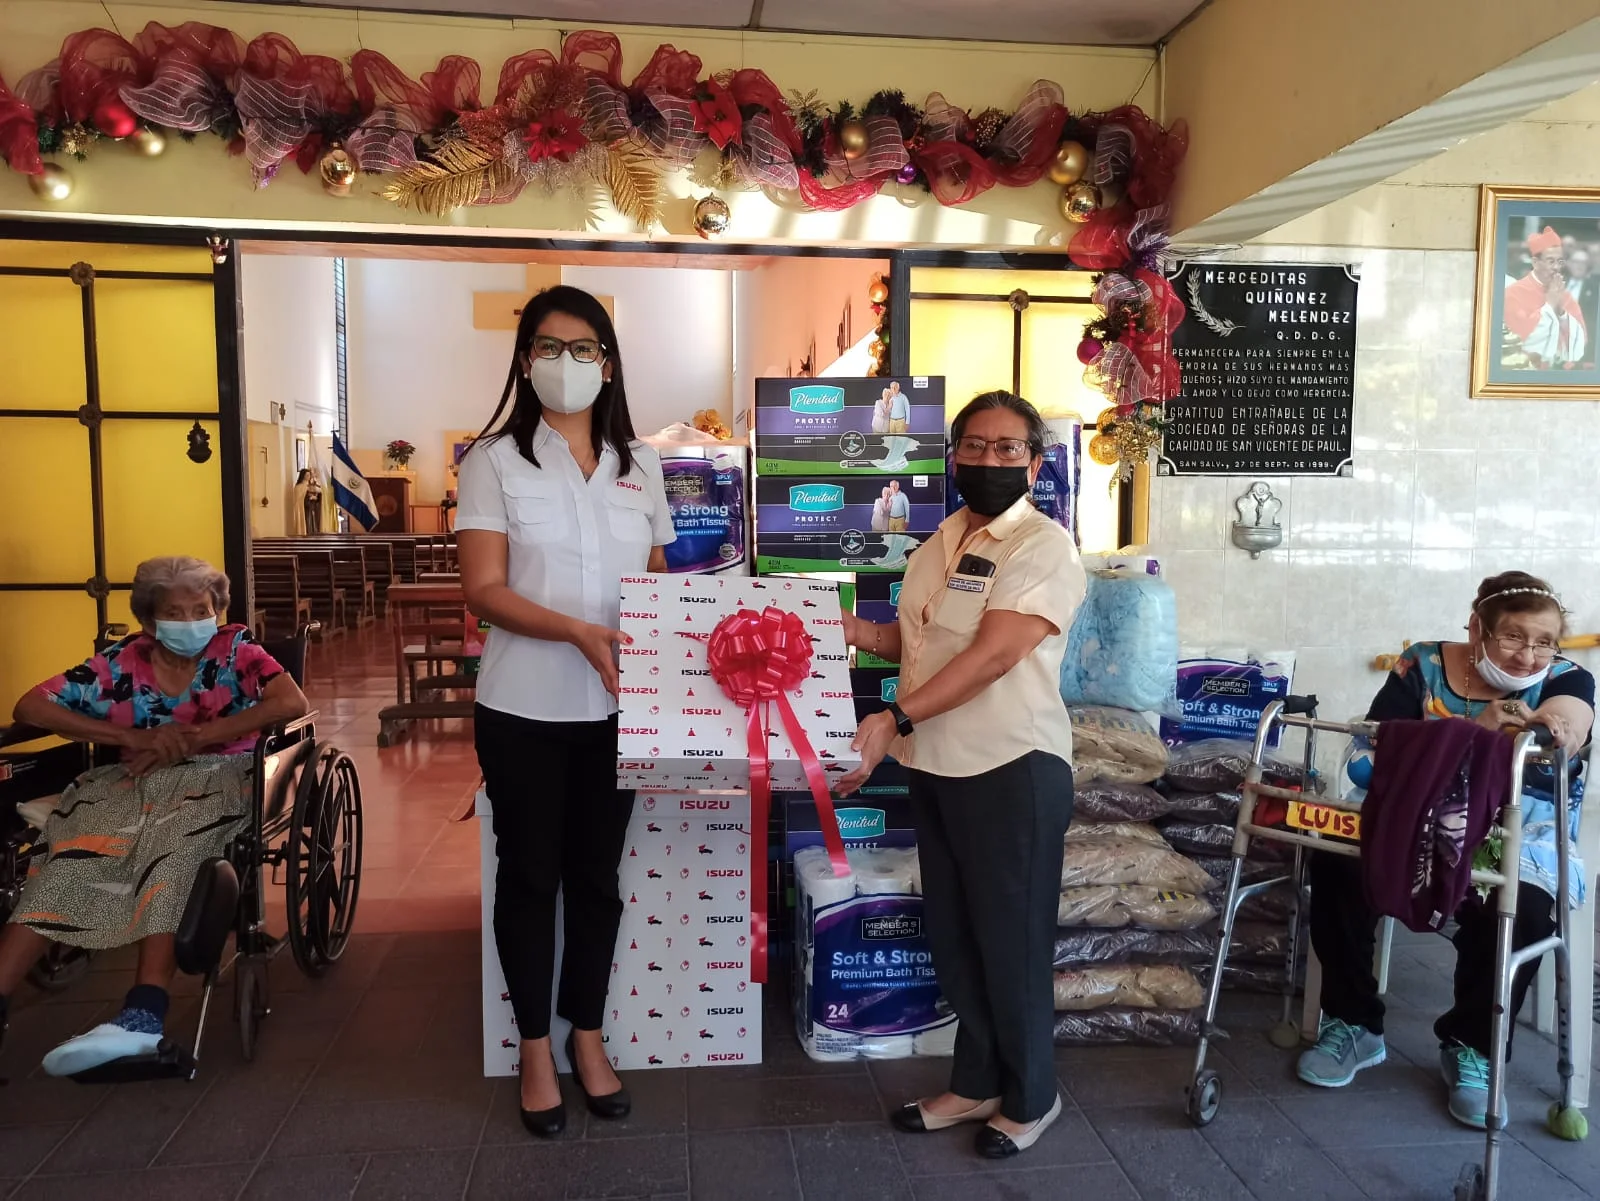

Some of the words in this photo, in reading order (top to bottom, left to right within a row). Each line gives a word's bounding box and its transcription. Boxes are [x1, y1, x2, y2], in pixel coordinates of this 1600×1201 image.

[1205, 271, 1307, 284] MERCEDITAS
[1245, 288, 1327, 304] QUIÑONEZ
[1268, 310, 1350, 323] MELENDEZ
[1172, 348, 1240, 358] PERMANECERA
[1246, 349, 1271, 358] PARA
[1277, 349, 1316, 358] SIEMPRE
[1322, 349, 1333, 358] EN
[1338, 349, 1350, 358] LA
[1180, 362, 1218, 370] EMORIA
[1224, 362, 1236, 371] DE
[1243, 362, 1262, 370] SUS
[1269, 362, 1323, 371] HERMANOS
[1329, 362, 1348, 371] MAS
[1226, 375, 1246, 384] HIZO
[1250, 376, 1273, 384] SUYO
[1276, 376, 1286, 384] EL
[1290, 376, 1349, 384] MANDAMIENTO
[1192, 388, 1217, 398] AMOR
[1222, 388, 1227, 398] Y
[1231, 389, 1242, 398] LO
[1248, 389, 1270, 398] DEJO
[1276, 389, 1299, 398] COMO
[794, 392, 840, 407] Plenitud
[1170, 406, 1224, 418] GRATITUD
[1232, 404, 1304, 418] ENTRAÑABLE
[1312, 407, 1326, 418] DE
[1334, 407, 1346, 418] LA
[1170, 423, 1224, 435] SOCIEDAD
[1232, 424, 1246, 435] DE
[1254, 420, 1304, 435] SEÑORAS
[1312, 424, 1324, 435] DE
[1332, 424, 1346, 435] LA
[1169, 440, 1212, 452] CARIDAD
[1216, 440, 1229, 452] DE
[1232, 440, 1252, 452] SAN
[1256, 440, 1299, 452] VICENTE
[1302, 440, 1314, 452] DE
[1317, 440, 1346, 452] PAUL.
[616, 480, 642, 492] ISUZU
[794, 491, 840, 504] Plenitud
[680, 504, 728, 517] Strong
[676, 518, 700, 528] Bath
[701, 518, 730, 526] Tissue
[1206, 686, 1245, 694] SELECTION
[1179, 699, 1205, 713] Soft
[1208, 702, 1218, 714] &
[1222, 704, 1262, 719] Stron
[1183, 714, 1215, 725] emium
[1216, 716, 1238, 728] Bath
[1240, 720, 1257, 730] Tiss
[679, 800, 730, 810] ISUZU
[706, 822, 744, 831] ISUZU
[706, 870, 744, 878] ISUZU
[706, 916, 744, 924] ISUZU
[868, 928, 915, 936] SELECTION
[832, 951, 868, 966] Soft
[874, 950, 886, 964] &
[891, 950, 932, 964] Stro
[706, 962, 744, 970] ISUZU
[831, 968, 883, 980] Premium
[886, 968, 912, 977] Bath
[916, 966, 936, 976] Tiss
[707, 1007, 744, 1016] ISUZU
[828, 1004, 848, 1018] 24
[707, 1053, 744, 1061] ISUZU
